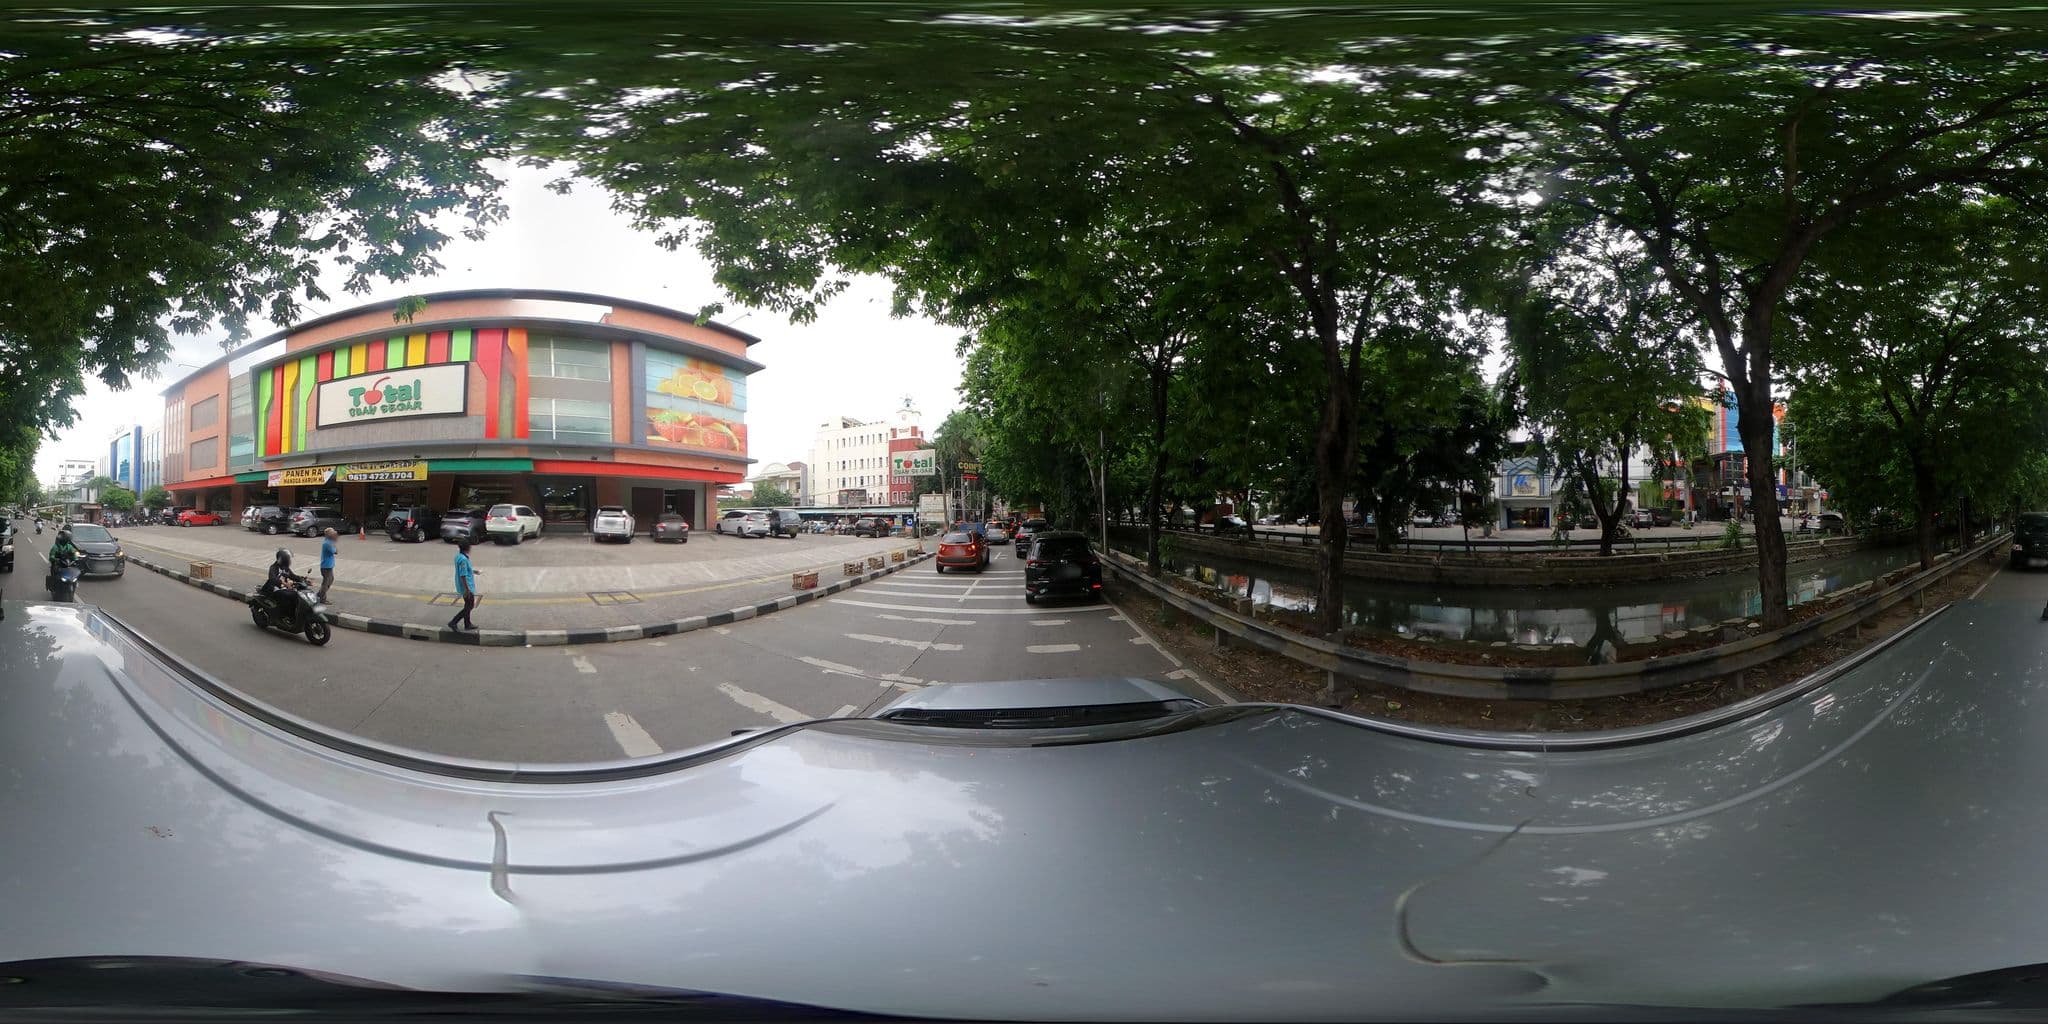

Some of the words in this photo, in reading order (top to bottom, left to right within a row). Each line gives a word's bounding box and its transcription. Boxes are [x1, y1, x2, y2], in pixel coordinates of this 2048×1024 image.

[348, 377, 422, 407] Total
[894, 456, 933, 469] Total
[286, 469, 310, 478] PANEN
